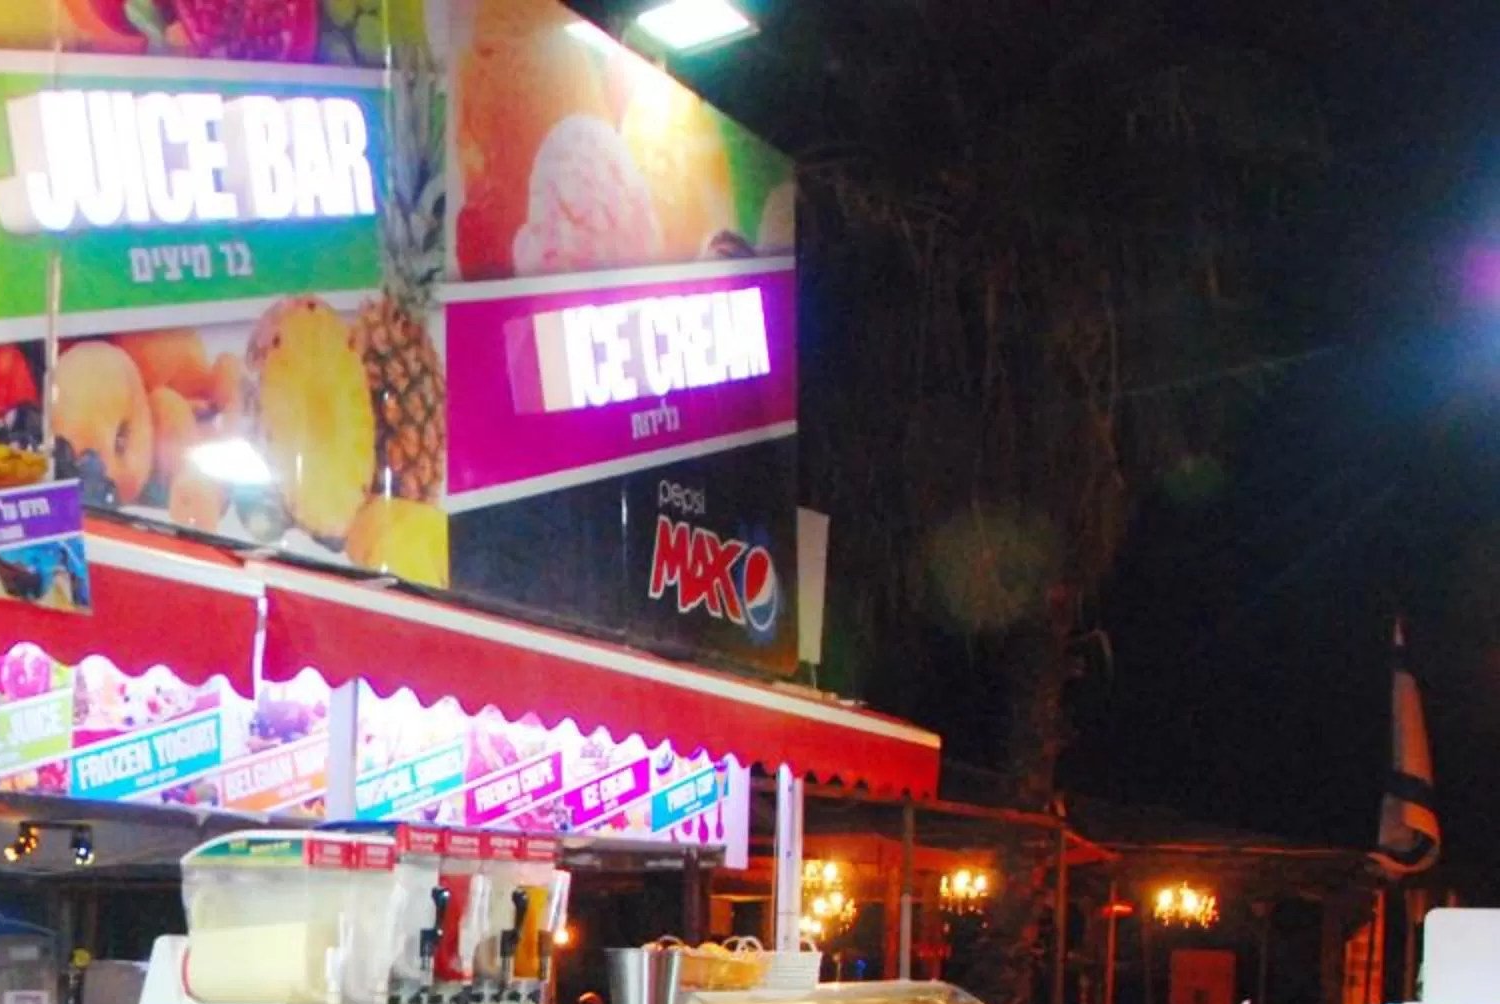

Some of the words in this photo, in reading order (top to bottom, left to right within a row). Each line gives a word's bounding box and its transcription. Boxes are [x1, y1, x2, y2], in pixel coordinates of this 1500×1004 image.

[241, 95, 376, 219] BAR
[129, 244, 212, 283] מיצים
[220, 241, 254, 277] בר
[540, 303, 638, 410] ICE
[638, 287, 771, 397] CREAM
[658, 479, 706, 515] pepsi
[648, 515, 746, 625] MAX
[8, 700, 66, 746] JUICE
[77, 740, 151, 791] FROZEN
